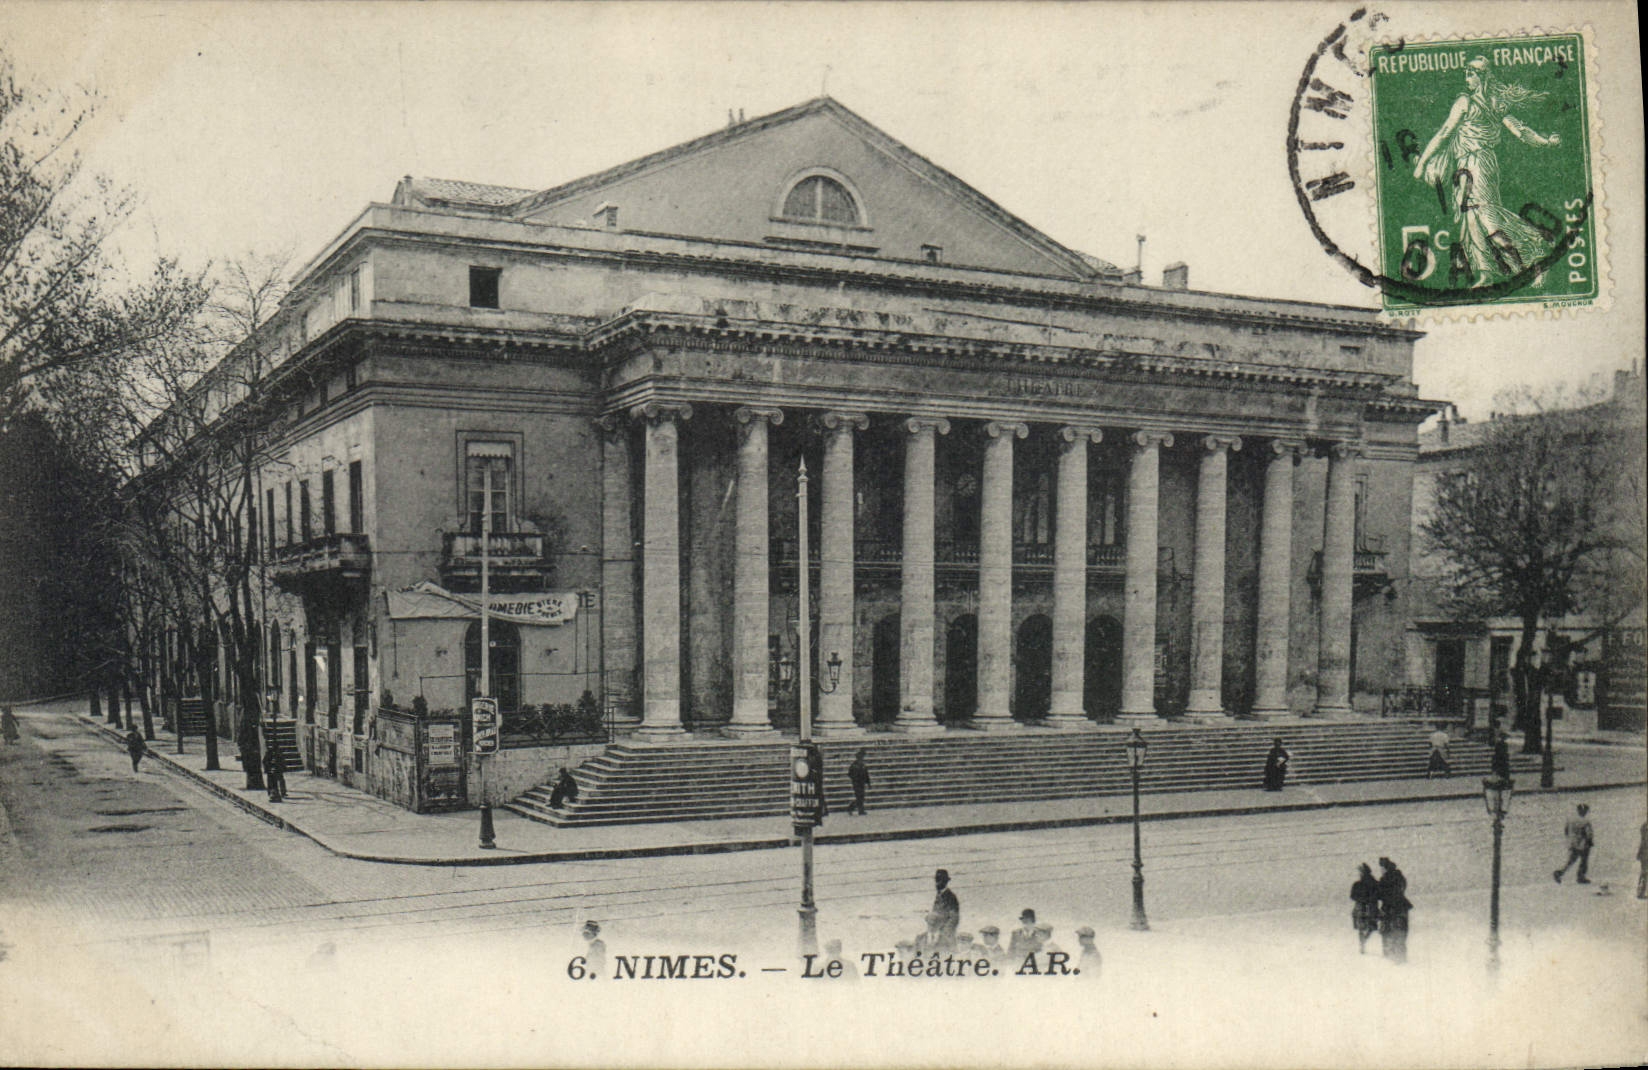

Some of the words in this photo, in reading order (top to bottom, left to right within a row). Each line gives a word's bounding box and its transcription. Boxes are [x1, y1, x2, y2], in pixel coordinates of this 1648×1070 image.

[1493, 44, 1575, 66] FRANÇAISE
[1564, 198, 1587, 284] POSTES
[487, 601, 535, 615] OMEDIE
